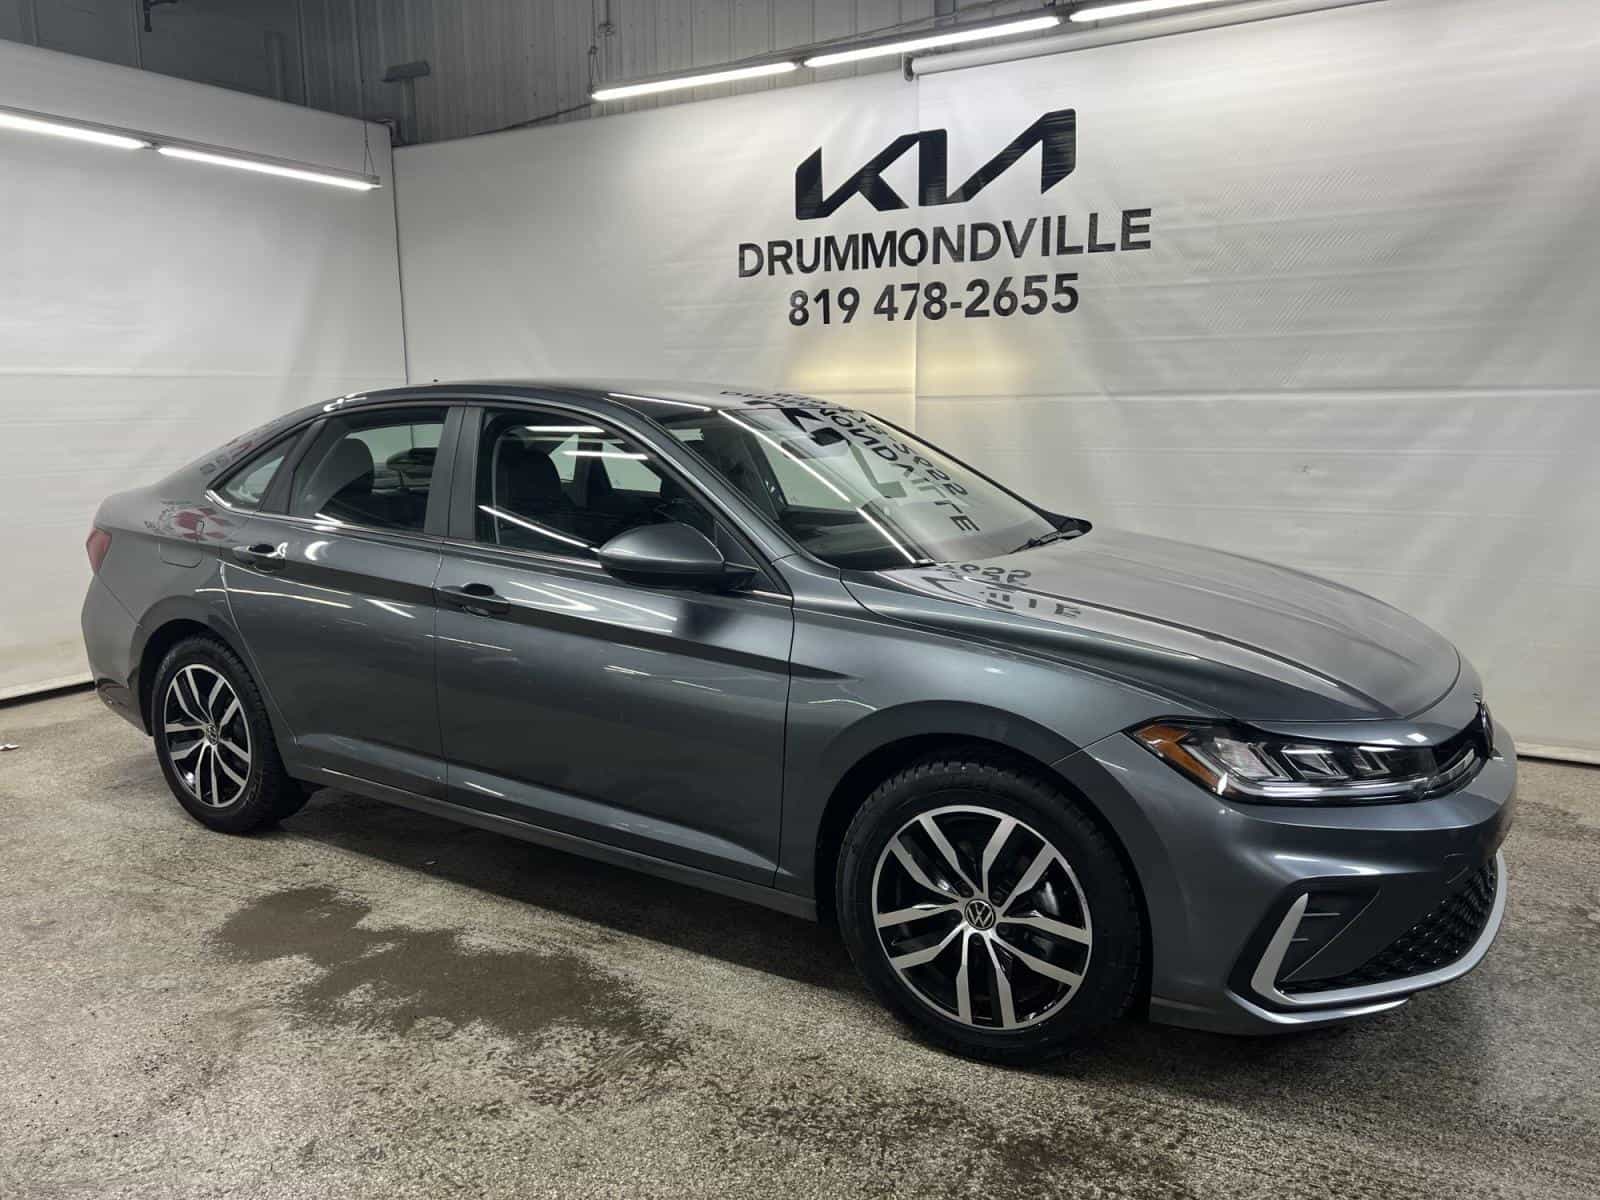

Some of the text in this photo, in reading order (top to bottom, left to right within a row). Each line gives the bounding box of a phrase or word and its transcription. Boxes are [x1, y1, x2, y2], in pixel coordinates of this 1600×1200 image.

[796, 108, 1076, 220] KIA
[738, 208, 1152, 278] DRUMMONDVILLE
[789, 272, 1079, 326] 819 478-2655
